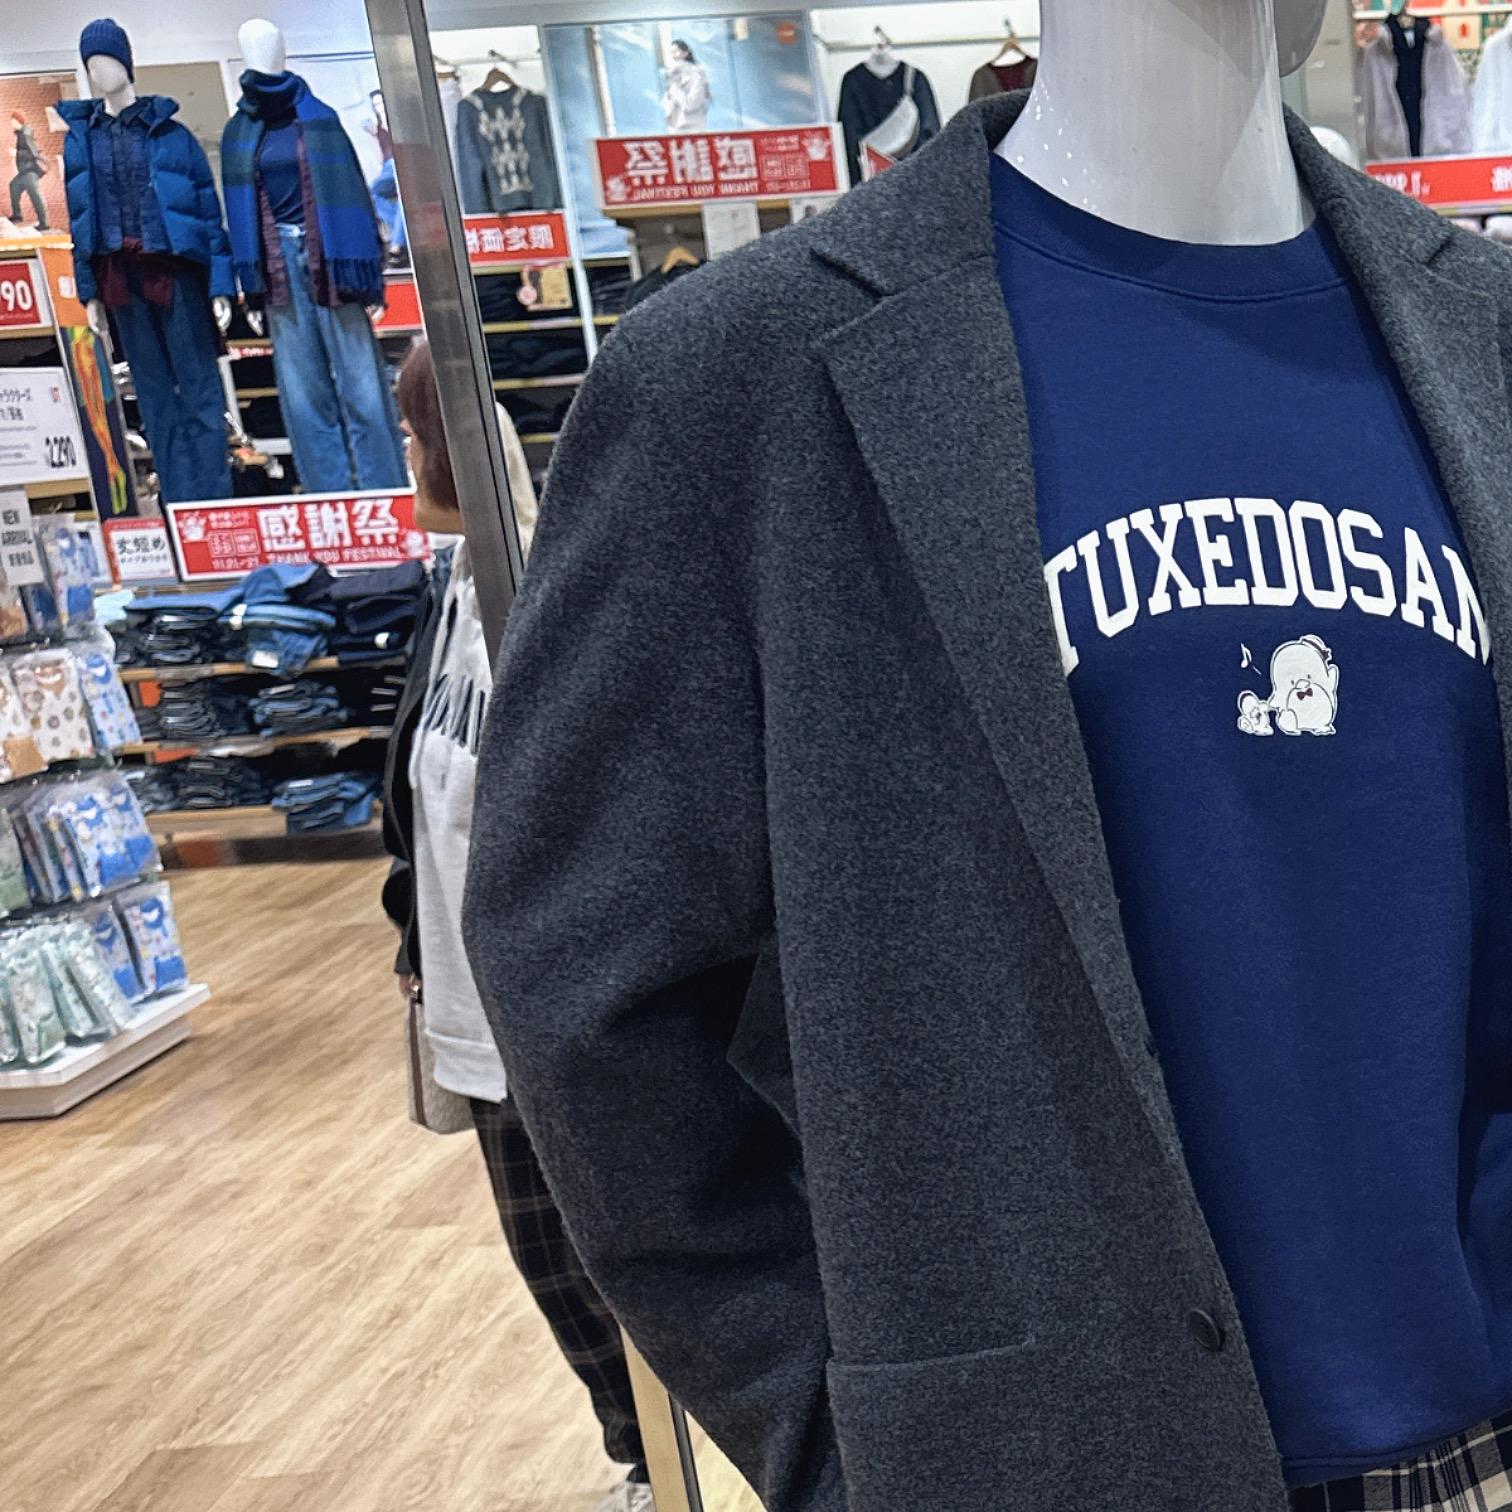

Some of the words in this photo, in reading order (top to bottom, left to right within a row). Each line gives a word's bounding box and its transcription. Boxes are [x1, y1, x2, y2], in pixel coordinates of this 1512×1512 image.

[257, 498, 399, 552] 感謝祭
[266, 552, 310, 567] THANK
[315, 549, 340, 563] YOU
[343, 546, 401, 562] FESTIVAL
